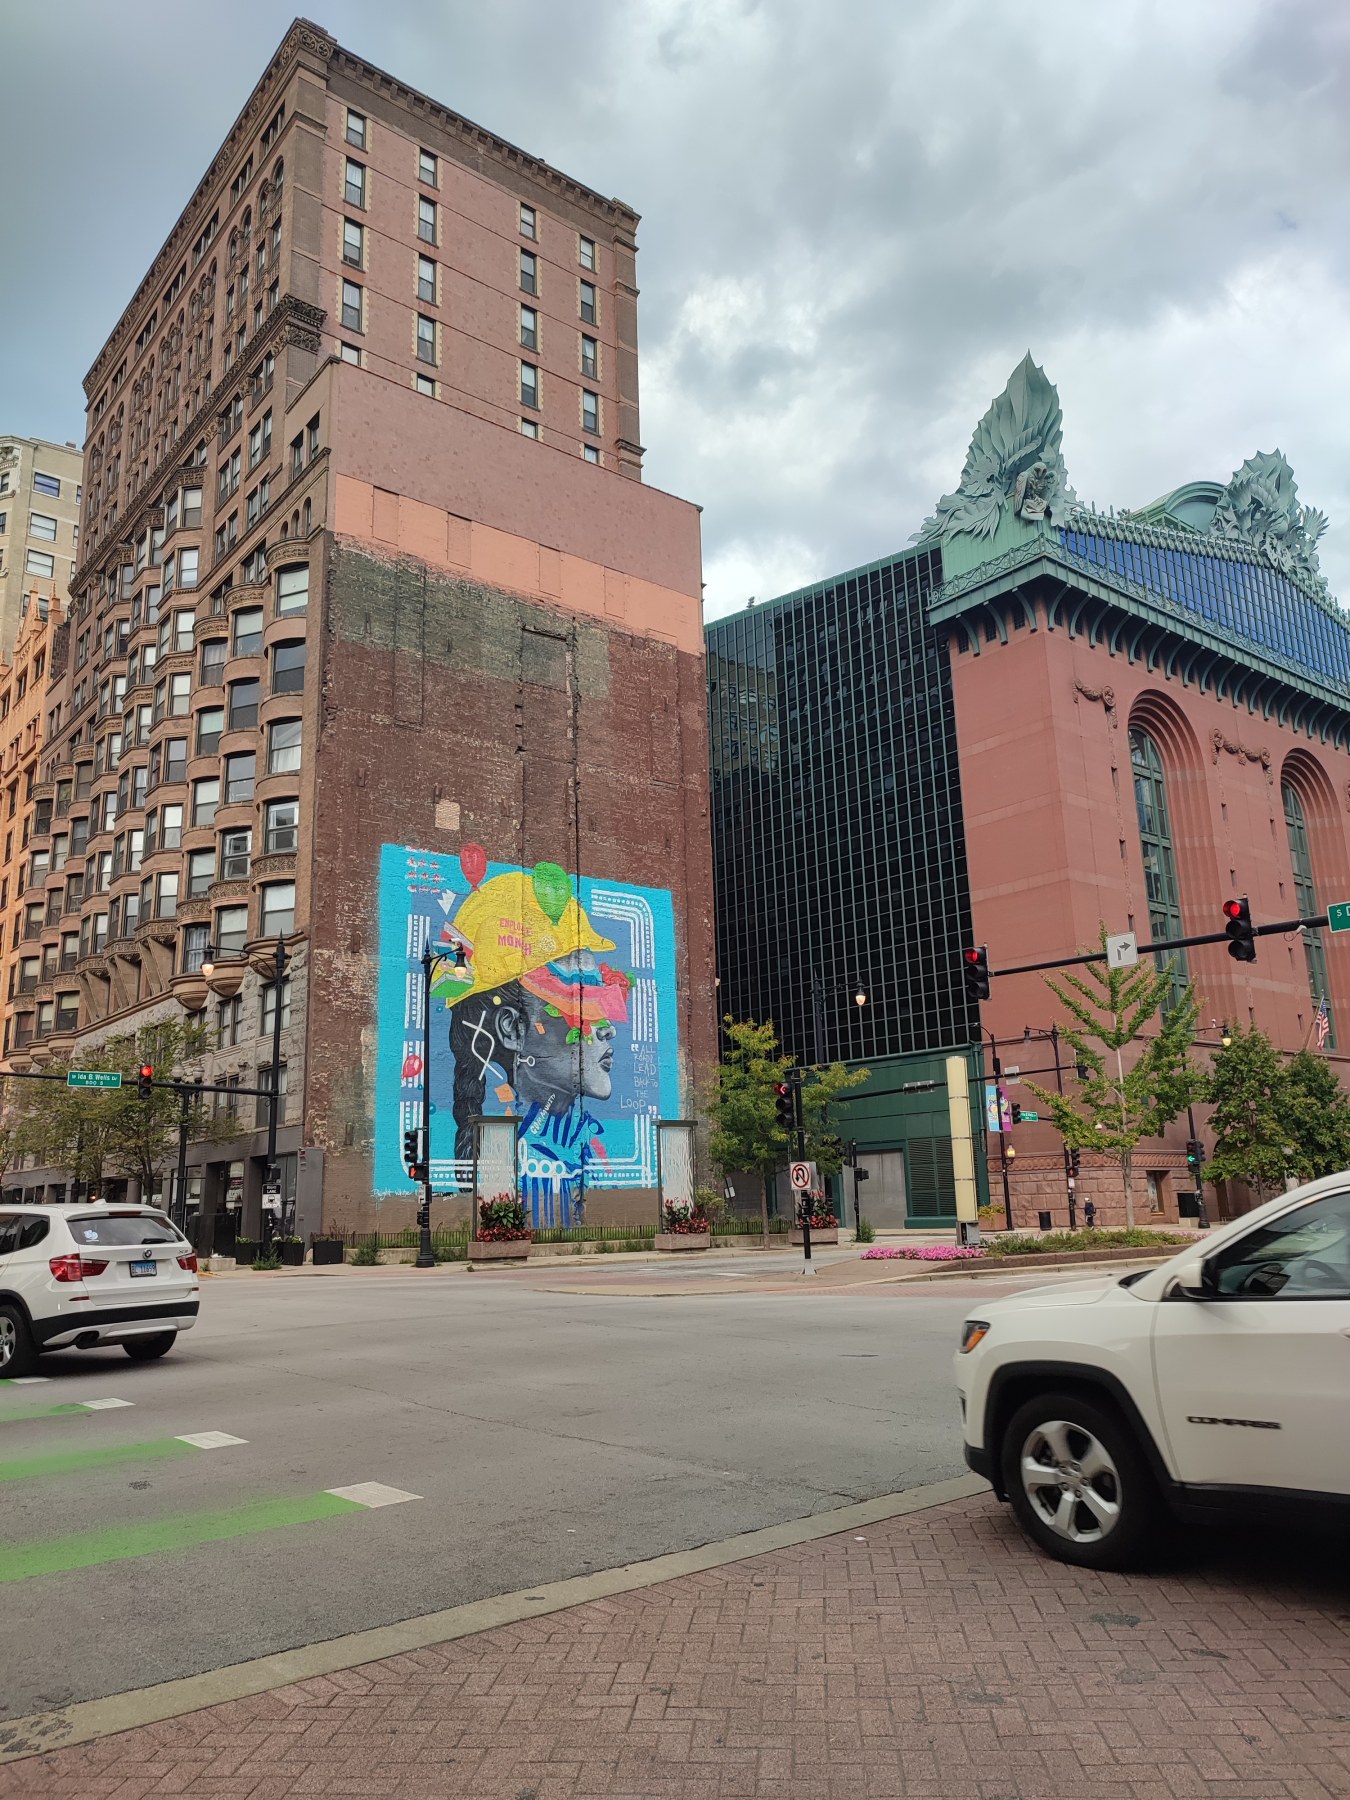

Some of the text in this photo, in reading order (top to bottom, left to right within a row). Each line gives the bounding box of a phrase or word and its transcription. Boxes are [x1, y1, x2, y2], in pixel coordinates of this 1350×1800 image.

[633, 1062, 657, 1077] LEAD
[634, 1089, 649, 1098] THE
[1186, 1416, 1282, 1430] COMPASS
